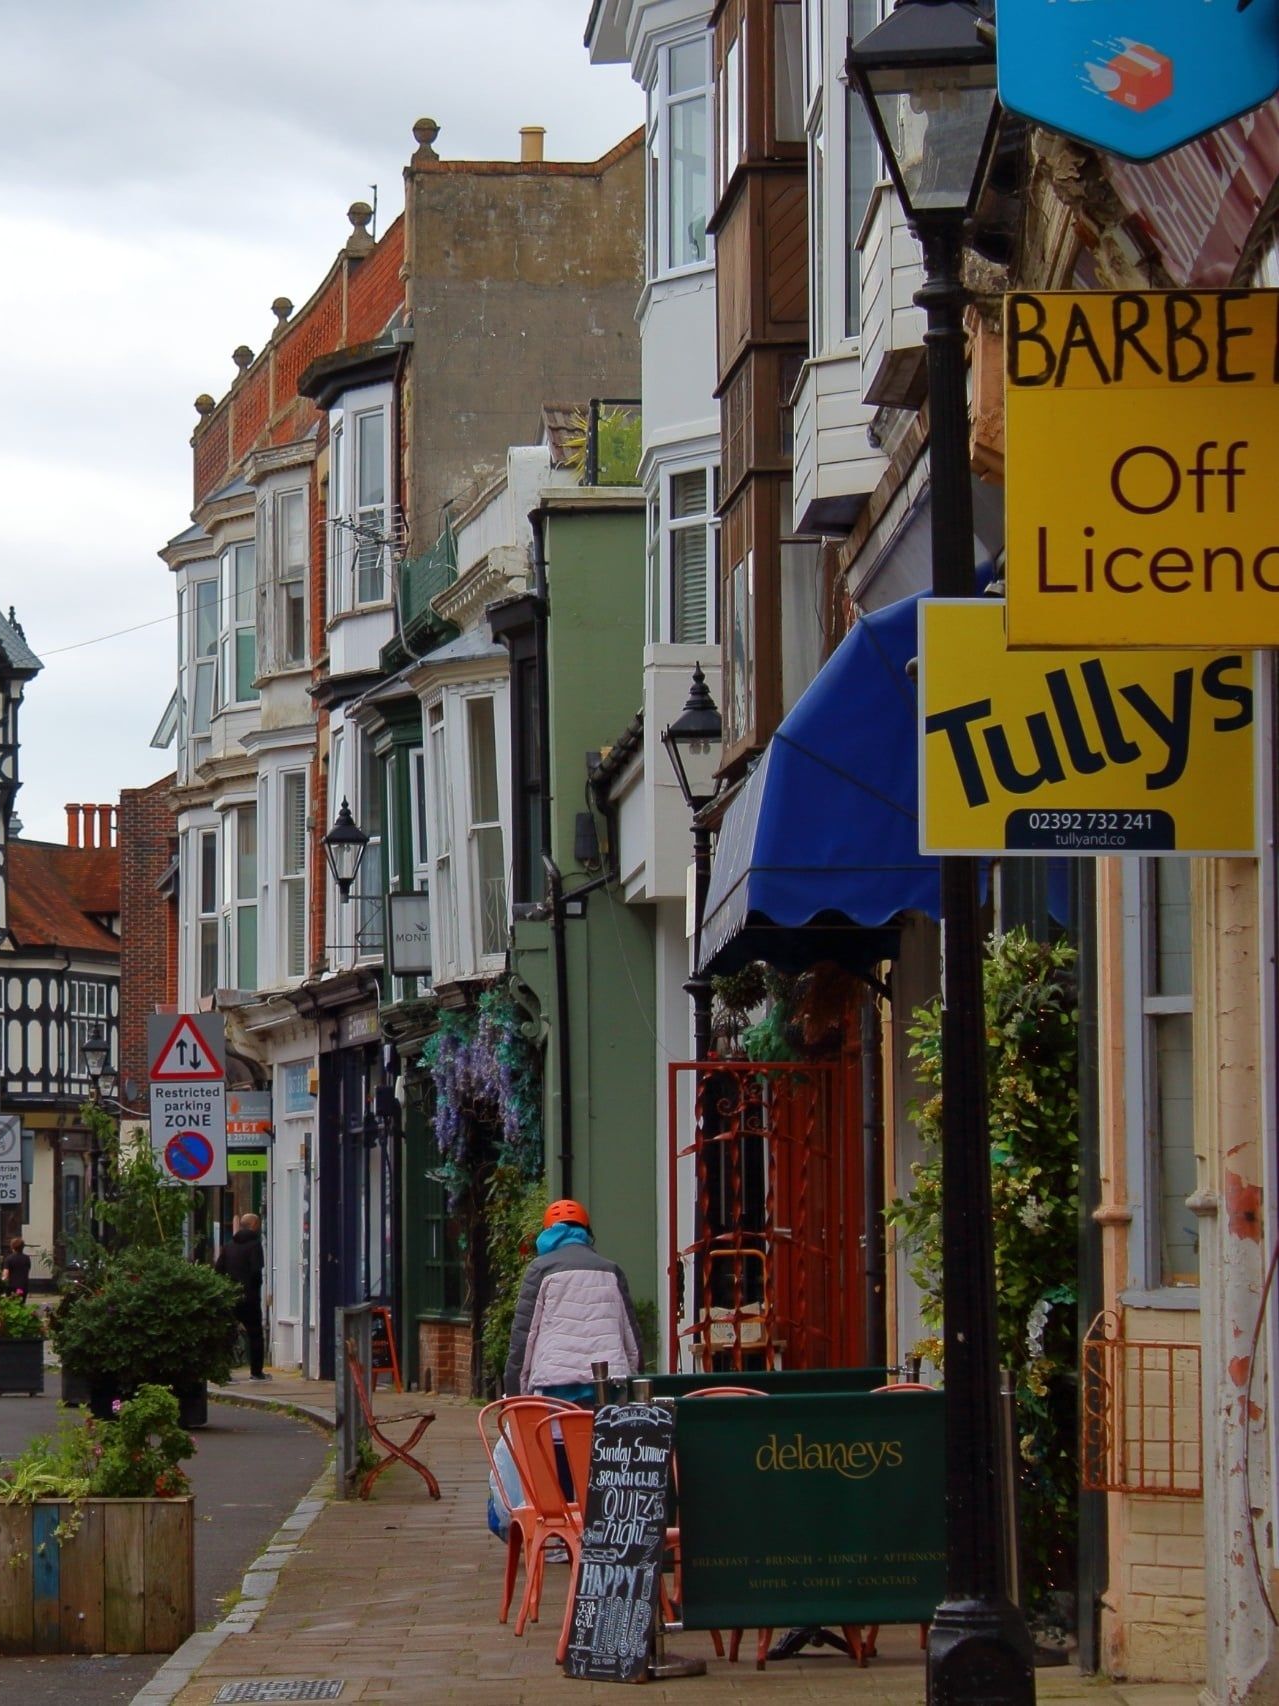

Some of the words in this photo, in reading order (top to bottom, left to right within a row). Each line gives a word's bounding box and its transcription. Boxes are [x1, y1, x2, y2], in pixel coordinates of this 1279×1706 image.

[1008, 293, 1279, 387] BARBE
[1111, 441, 1248, 515] Off
[925, 656, 1254, 808] Tullys
[1029, 813, 1082, 830] 02392
[1087, 813, 1118, 830] 732
[1122, 813, 1152, 830] 241
[1055, 833, 1126, 848] tullyand.co
[155, 1087, 220, 1098] Restricted
[164, 1101, 212, 1114] parking
[165, 1114, 212, 1127] ZONE
[233, 1122, 258, 1133] LET
[593, 1437, 632, 1473] Sunday
[632, 1436, 669, 1463] Summer
[756, 1433, 903, 1479] delaneys
[596, 1471, 633, 1487] BRUNCH
[634, 1471, 659, 1487] CLUB
[602, 1486, 655, 1521] QUIZ
[603, 1519, 646, 1559] night
[693, 1557, 749, 1568] BREAKFAST
[765, 1555, 813, 1566] BRUNCH
[828, 1553, 868, 1565] LUNCH
[580, 1563, 638, 1599] HAPPY
[749, 1578, 788, 1589] SUPPER
[802, 1576, 841, 1588] COFFEE
[857, 1575, 919, 1586] COCKTAILS
